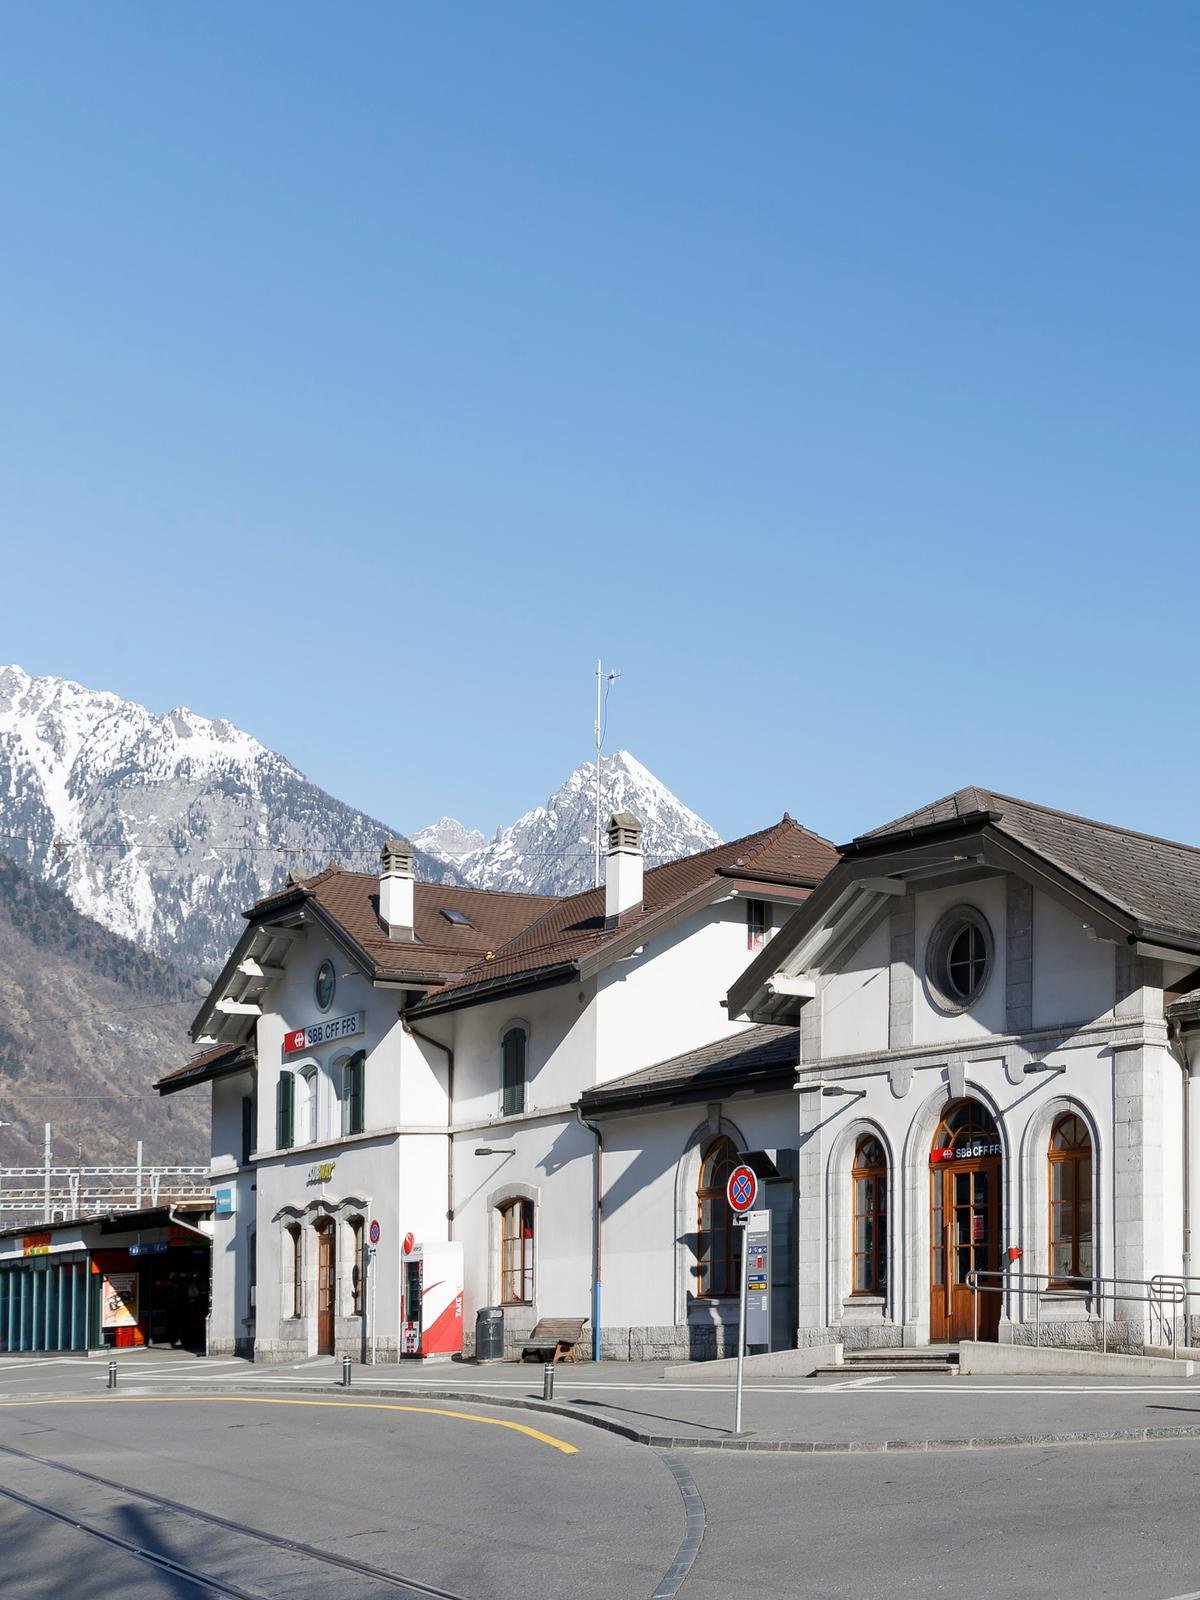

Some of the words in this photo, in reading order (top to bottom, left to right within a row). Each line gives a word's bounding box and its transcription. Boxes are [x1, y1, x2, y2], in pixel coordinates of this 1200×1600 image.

[307, 1027, 323, 1044] SBB
[325, 1022, 340, 1039] CFF
[341, 1016, 356, 1035] FFS
[955, 1147, 972, 1158] SBB
[972, 1145, 988, 1157] CFF
